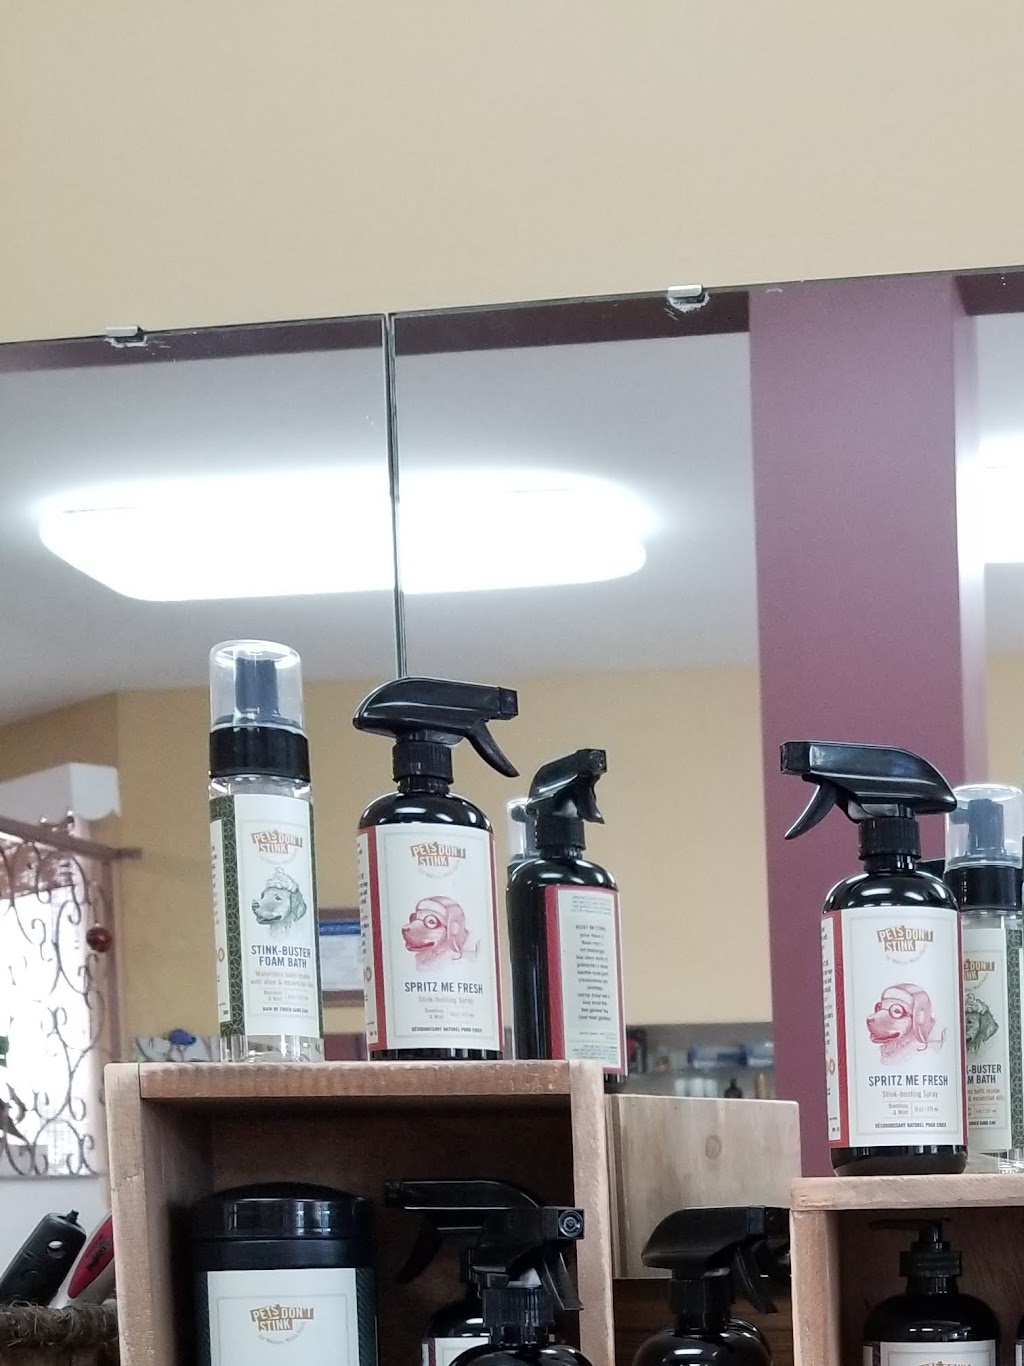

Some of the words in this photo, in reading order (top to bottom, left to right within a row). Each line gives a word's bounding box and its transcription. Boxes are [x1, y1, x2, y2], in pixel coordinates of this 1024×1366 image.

[878, 925, 904, 942] PETS
[905, 928, 934, 942] DON'T
[251, 945, 311, 958] STINK-BUSTER
[884, 940, 916, 952] STINK
[259, 956, 285, 966] FOAM
[288, 958, 307, 968] BATH
[405, 981, 438, 993] SPRITZ
[441, 981, 455, 993] ME
[457, 982, 484, 994] FRESH
[868, 1075, 903, 1087] SPRITZ
[905, 1075, 919, 1086] ME
[922, 1075, 949, 1086] FRESH
[976, 1074, 996, 1084] BATH
[250, 1305, 279, 1321] PETS
[280, 1307, 314, 1320] DON'T
[258, 1319, 293, 1331] STINK
